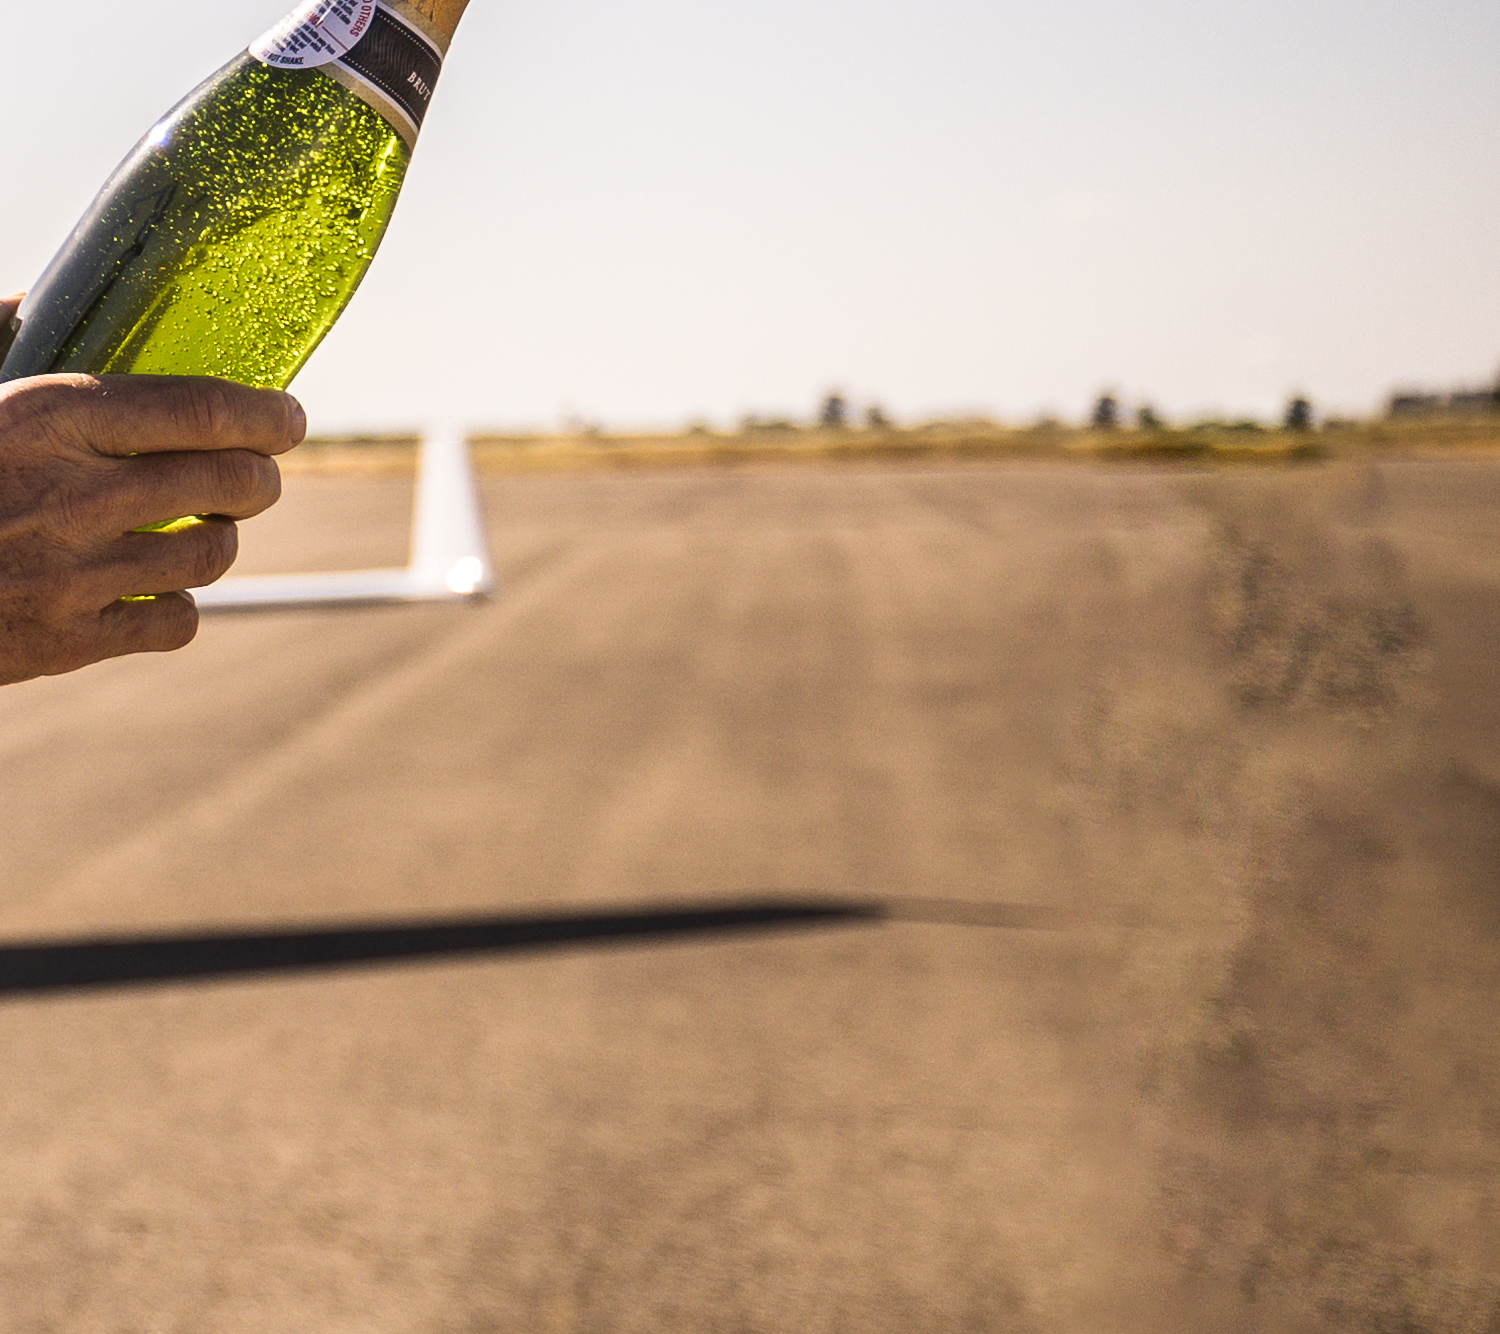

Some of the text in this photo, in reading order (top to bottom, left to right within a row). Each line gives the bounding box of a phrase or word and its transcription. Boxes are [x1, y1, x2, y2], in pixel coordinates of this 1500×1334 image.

[349, 5, 373, 38] OTHERS
[267, 52, 282, 63] NOT
[280, 55, 305, 65] SHAKE
[406, 71, 431, 101] BRUT
